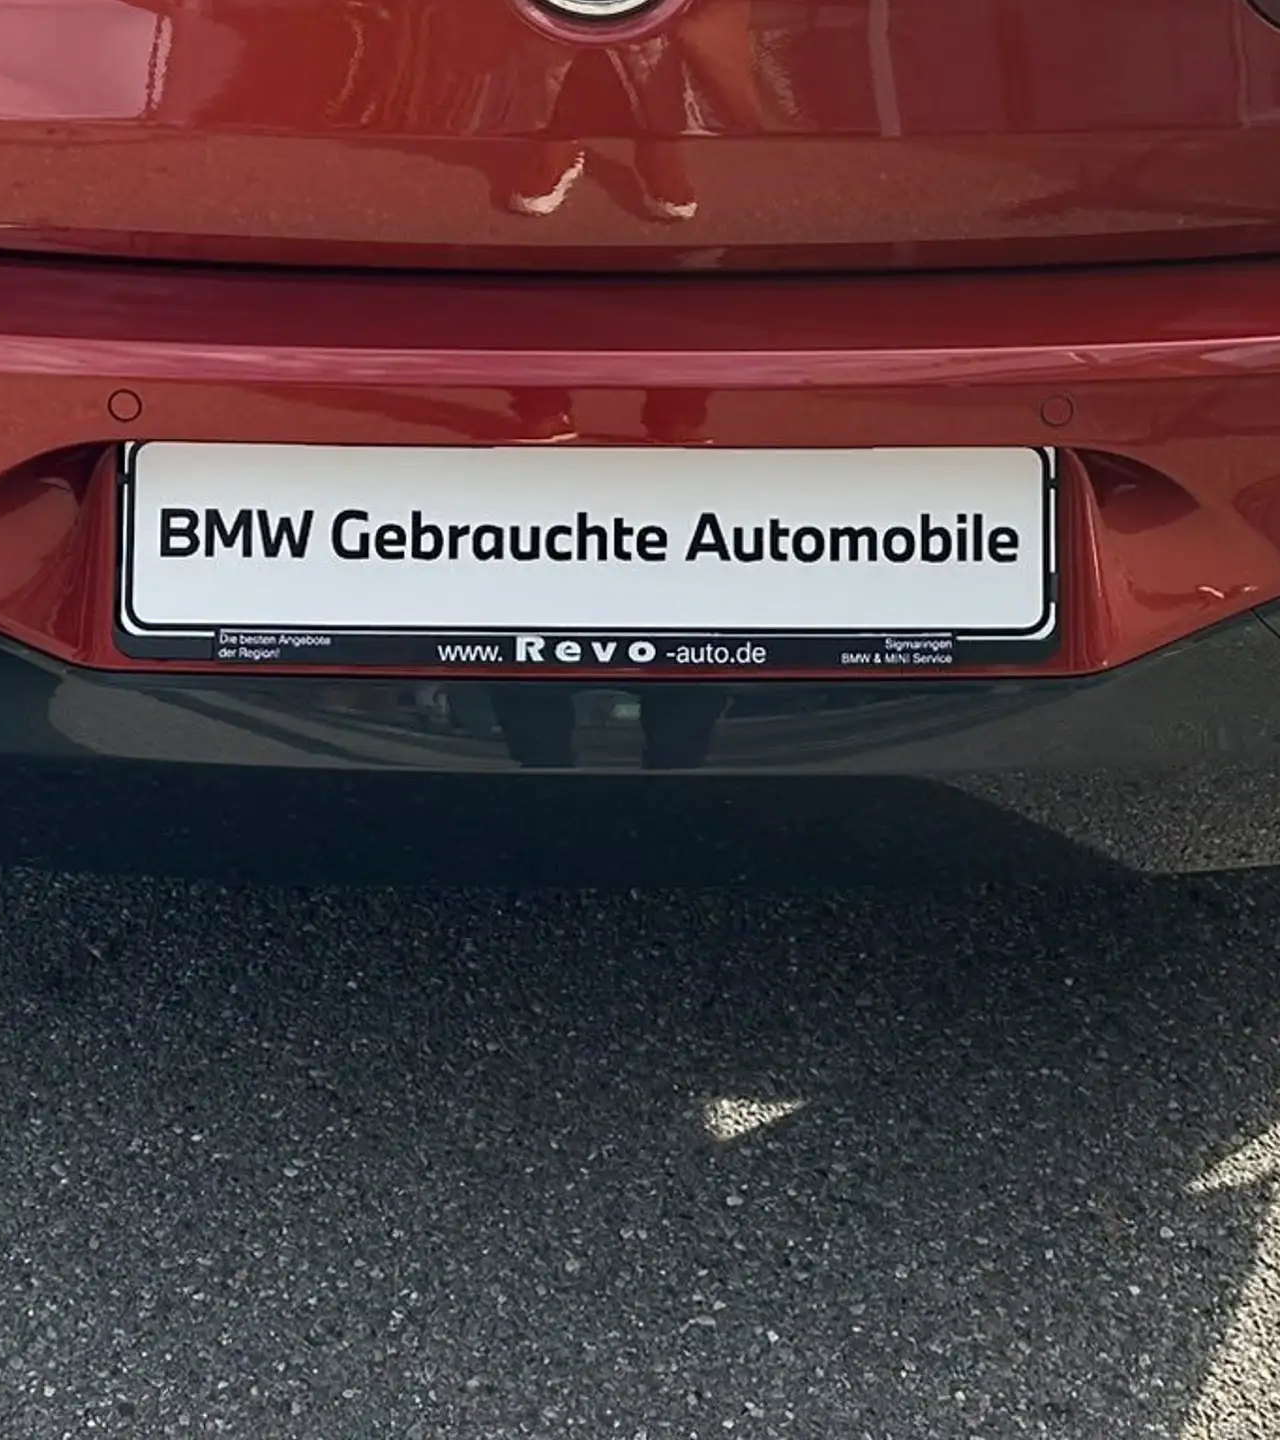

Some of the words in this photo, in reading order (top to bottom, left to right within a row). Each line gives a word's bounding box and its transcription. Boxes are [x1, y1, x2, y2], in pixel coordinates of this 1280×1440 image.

[159, 508, 315, 558] BMW
[331, 509, 668, 561] Gebrauchte
[685, 512, 1019, 562] Automobile
[220, 633, 237, 645] Die
[239, 633, 277, 645] besten
[278, 634, 331, 647] Angebote
[884, 637, 953, 651] Sigmaringen
[218, 647, 237, 658] der
[841, 652, 872, 664] BMW
[873, 652, 881, 664] &
[885, 652, 911, 664] MINI
[913, 652, 953, 664] Service
